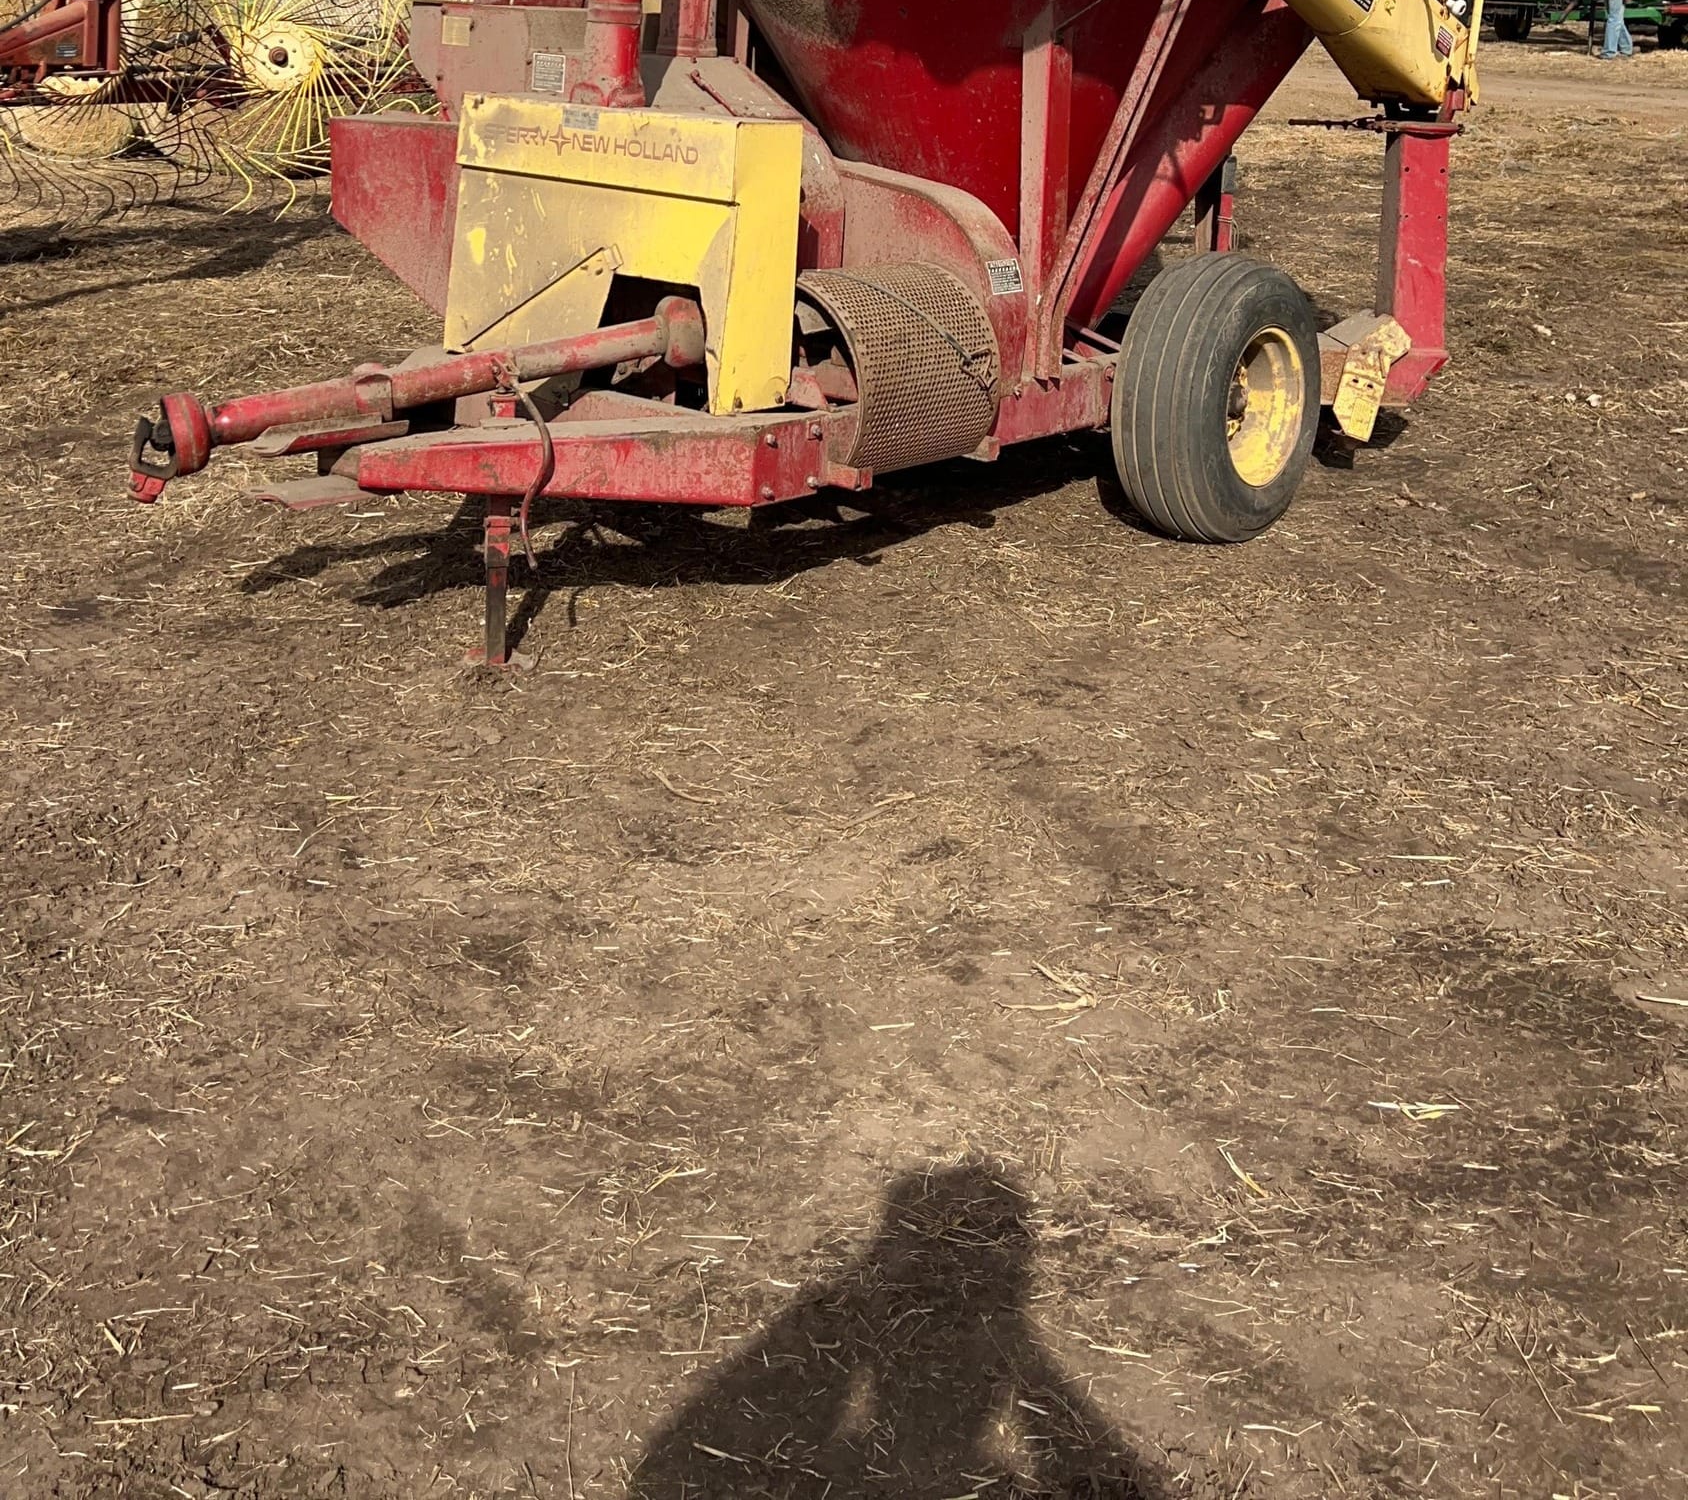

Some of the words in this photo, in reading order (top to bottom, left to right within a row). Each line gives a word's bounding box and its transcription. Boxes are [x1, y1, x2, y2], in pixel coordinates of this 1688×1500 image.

[484, 122, 550, 147] SPERRY
[572, 132, 610, 154] NEW
[614, 137, 699, 165] HOLLAND
